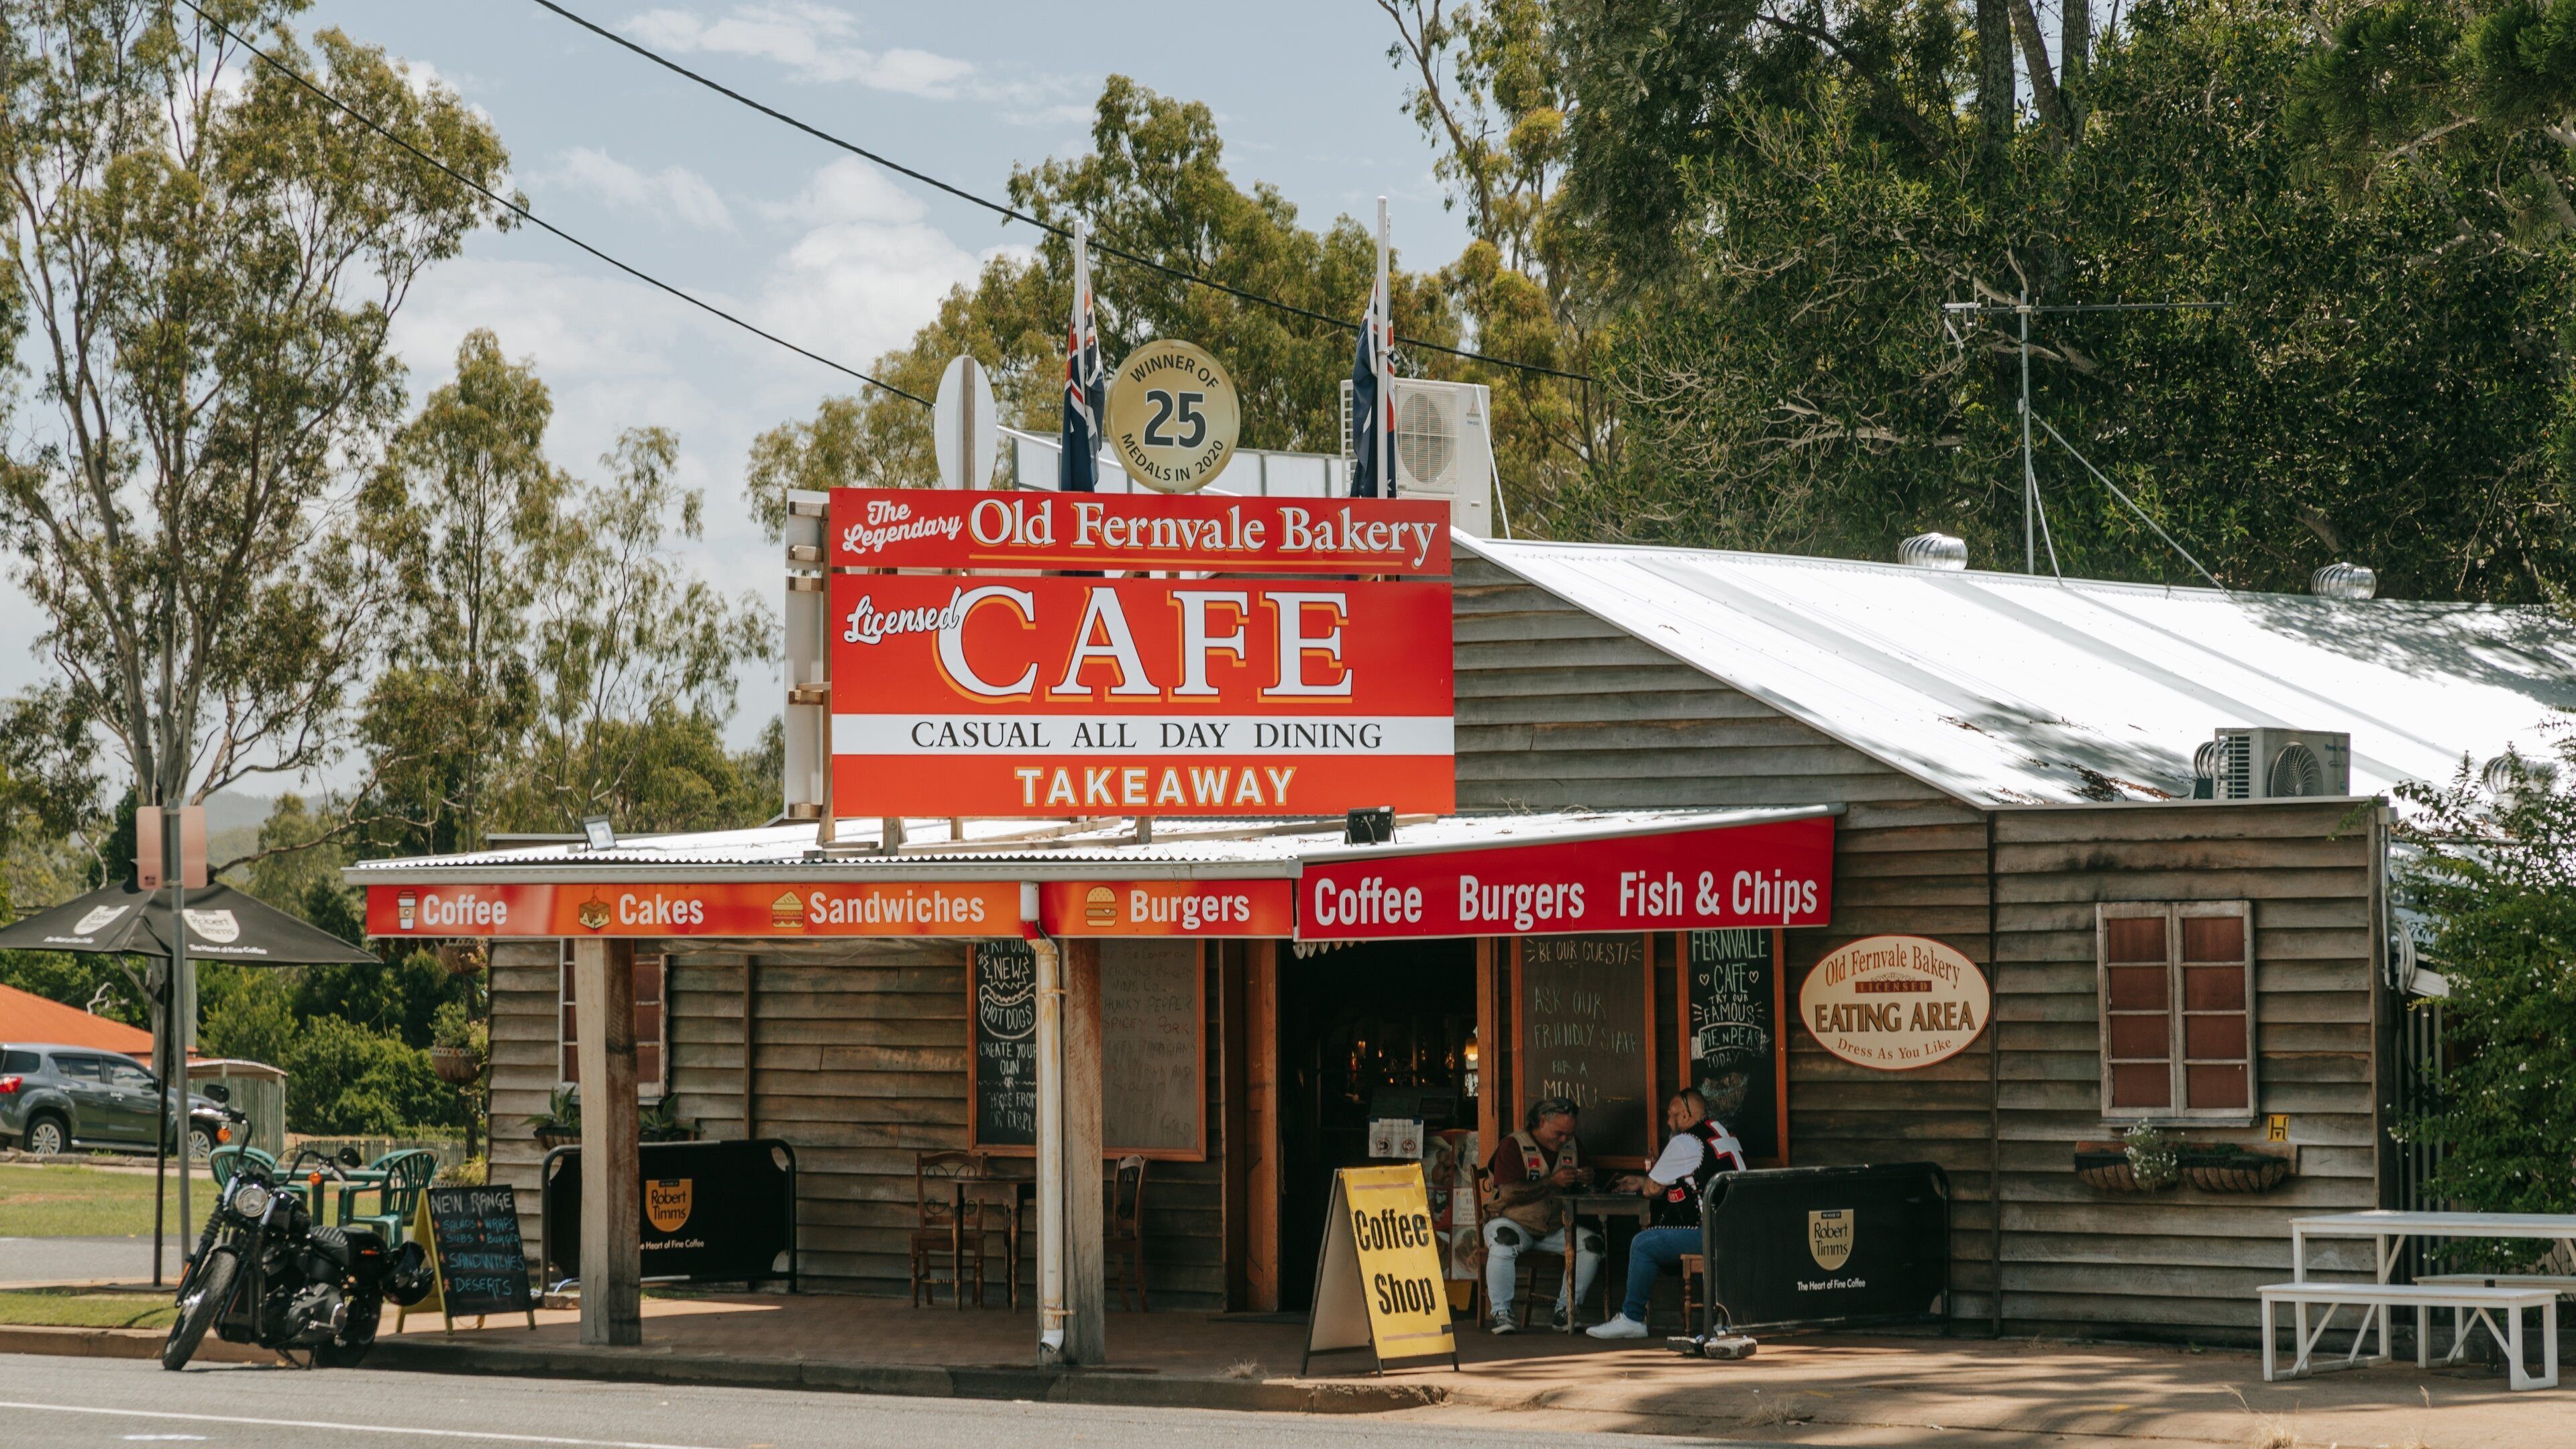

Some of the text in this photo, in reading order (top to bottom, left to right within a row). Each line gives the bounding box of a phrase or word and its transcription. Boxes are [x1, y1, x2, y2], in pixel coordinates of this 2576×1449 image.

[1130, 354, 1219, 388] WINNER OF
[1144, 389, 1207, 449] 25
[1122, 433, 1223, 482] MEDALS IN 2020
[867, 500, 911, 526] The
[842, 515, 963, 554] Legendary
[969, 498, 1438, 569] Old Fernvale Bakery
[843, 586, 961, 645] Licensed
[933, 585, 1352, 703] CAFE
[911, 721, 1382, 750] CASUAL ALL DAY DINING
[1014, 765, 1297, 807] TAKEAWAY
[423, 889, 1250, 930] Coffee Cakes Sandwiches Burgers
[1315, 868, 1817, 930] Coffee Burgers Fish & Chips
[1539, 941, 1629, 965] BE OUR GUEST!
[1693, 929, 1768, 962] FERNVALE
[994, 957, 1022, 980] NEW
[1714, 963, 1748, 994] CAFE
[1825, 943, 1961, 990] Old Fernvale Bakery
[1708, 994, 1749, 1004] TRY OUR
[1860, 981, 1929, 992] LICENSED
[1535, 986, 1606, 1020] ASK OUR
[1704, 1002, 1755, 1026] FAMOUS
[983, 1002, 1032, 1030] HOT DOGS
[1815, 1001, 1976, 1032] EATING AREA
[979, 1042, 1013, 1058] CREATE
[1701, 1028, 1719, 1051] PIE
[1837, 1037, 1953, 1060] Dress As You Like
[1000, 1059, 1019, 1075] OWN
[1580, 1062, 1589, 1079] A
[431, 1192, 513, 1216] NEW RANGE
[651, 1188, 687, 1205] Robert
[652, 1205, 687, 1220] Timms
[443, 1218, 515, 1233] SALADS WRAPS
[1354, 1209, 1430, 1252] Coffee
[1814, 1221, 1848, 1239] Robert
[445, 1234, 474, 1244] SUBS
[645, 1241, 663, 1250] Heart
[663, 1240, 670, 1249] of
[672, 1239, 684, 1248] Fine
[685, 1238, 704, 1248] Coffee
[1815, 1240, 1848, 1256] Timms
[455, 1277, 513, 1299] DESERTS
[1375, 1273, 1436, 1316] Shop
[1797, 1277, 1866, 1291] The Heart of Fine Coffee
